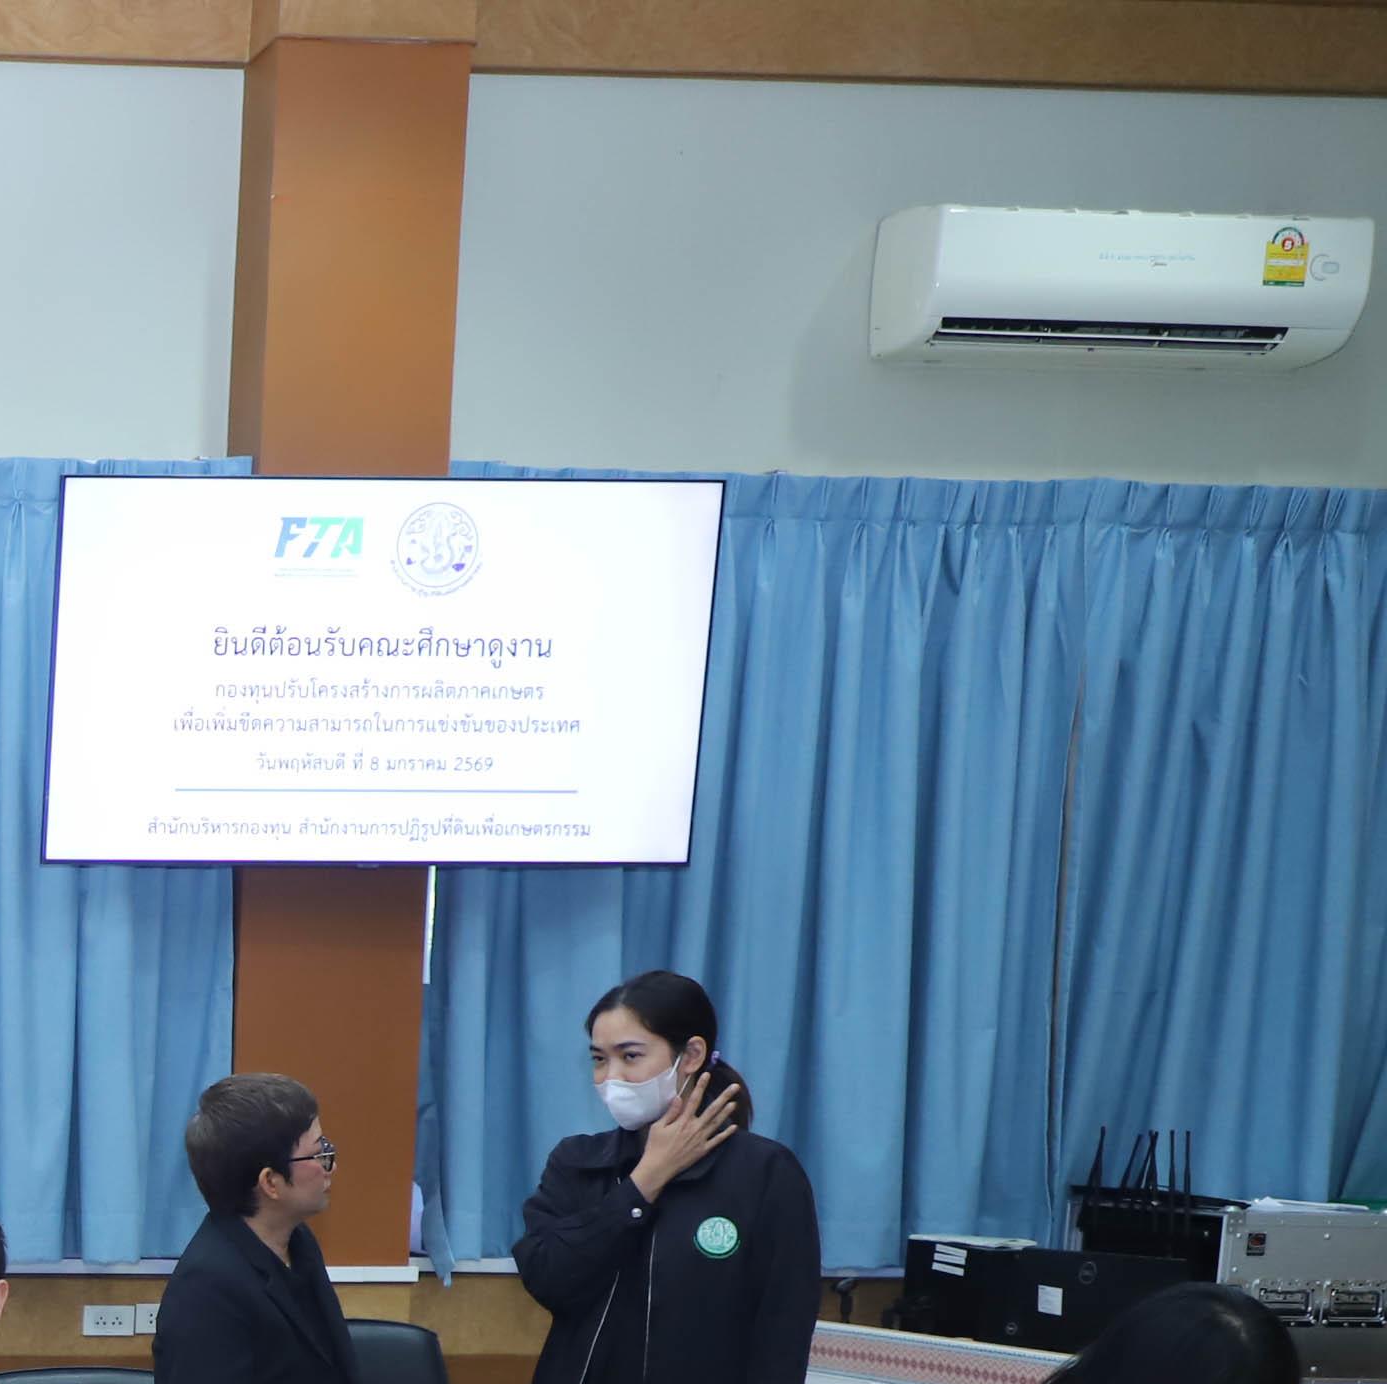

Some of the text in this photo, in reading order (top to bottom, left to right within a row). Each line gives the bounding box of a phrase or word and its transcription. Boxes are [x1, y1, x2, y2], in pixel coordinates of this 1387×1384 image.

[274, 516, 365, 560] FTA
[213, 625, 553, 669] ยินดีต้อนรับคณะศึกษาดูงาน
[216, 677, 545, 704] กองทุนปรับโครงสร้างการผลิตภาคเกษตร
[173, 706, 581, 735] เพื่อเพิ่มขีดความสามารถในการแข่งขันของประเทศ
[257, 749, 494, 773] วันพฤหัสบดี ที่ 8 มกราคม 2569
[147, 816, 291, 840] สำนักบริหารกองทุน
